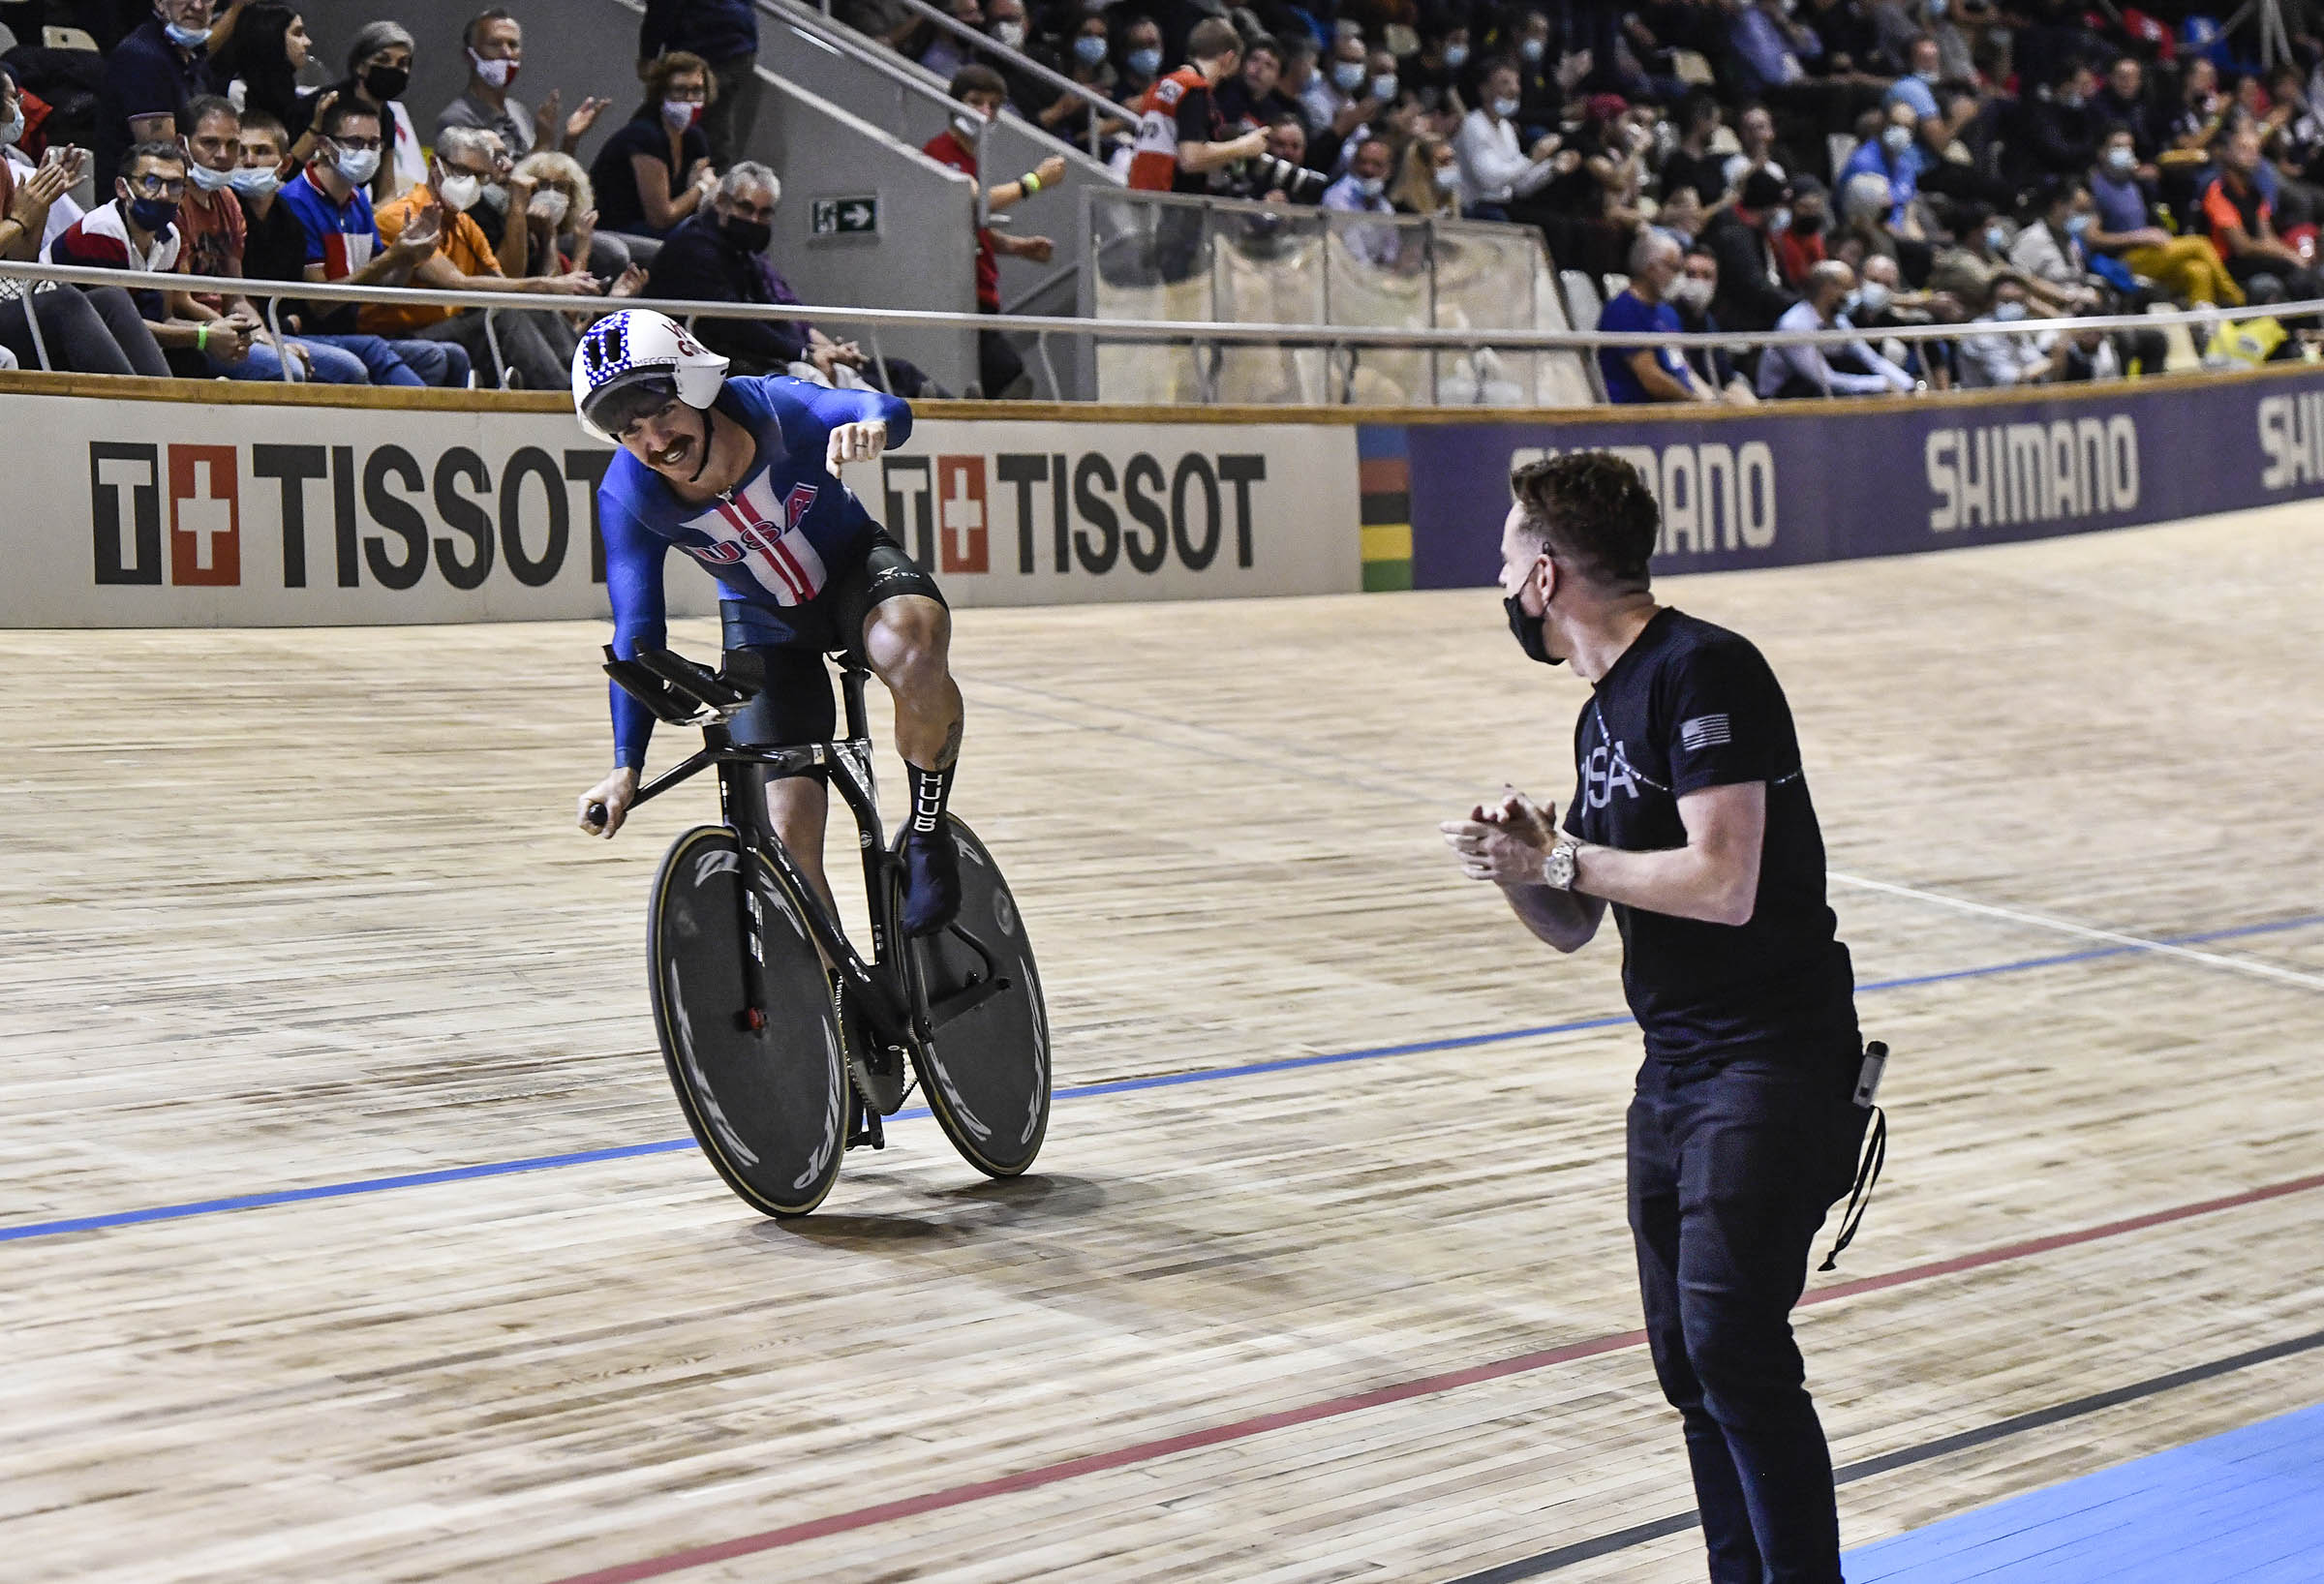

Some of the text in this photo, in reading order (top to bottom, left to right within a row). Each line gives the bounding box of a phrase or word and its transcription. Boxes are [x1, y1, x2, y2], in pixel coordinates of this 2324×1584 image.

[253, 443, 614, 591] TISSOT
[686, 482, 818, 565] USA
[996, 451, 1267, 575] TISSOT
[1925, 414, 2139, 532] SHIMANO
[914, 773, 942, 833] HUUB
[1581, 741, 1640, 819] USA
[694, 849, 806, 940] ZIP
[793, 1014, 841, 1190] ZIPP
[927, 1042, 993, 1142] ZIP
[1019, 955, 1045, 1144] ZIPP
